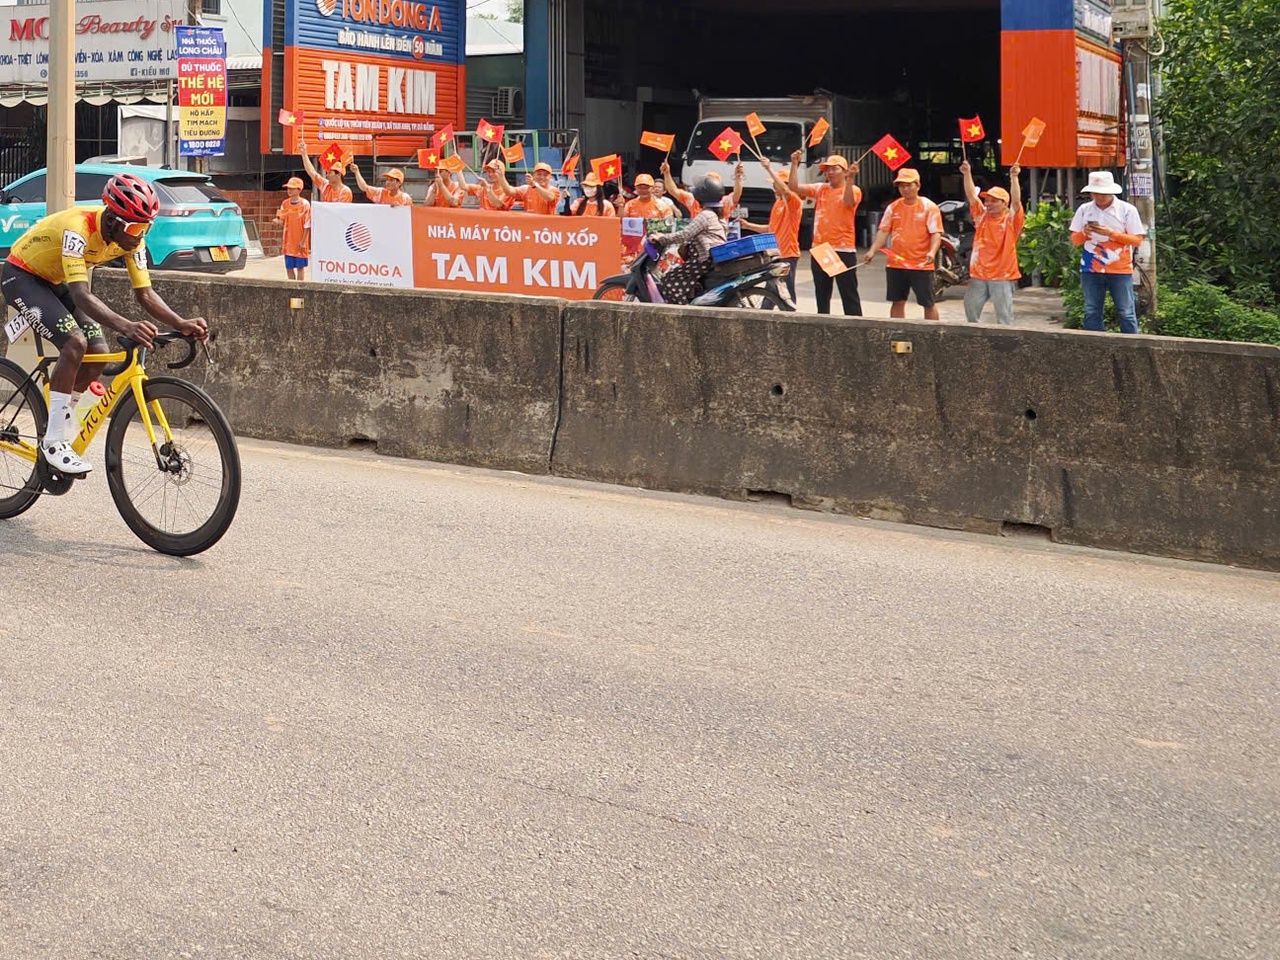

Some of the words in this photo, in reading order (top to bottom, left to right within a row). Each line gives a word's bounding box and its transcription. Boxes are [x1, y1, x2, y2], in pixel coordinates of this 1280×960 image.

[75, 14, 157, 40] Beauty
[428, 5, 443, 33] A
[178, 46, 201, 55] LONG
[201, 45, 223, 55] CHÂU
[181, 37, 195, 45] NHÀ
[337, 26, 356, 46] BẢO
[380, 33, 396, 51] LÊN
[396, 34, 412, 53] ĐẾN
[414, 42, 425, 54] 50
[166, 48, 178, 61] LAS
[181, 61, 193, 72] ĐỦ
[194, 60, 222, 72] THUỐC
[178, 73, 205, 90] THẾ
[207, 74, 225, 92] HỆ
[322, 59, 380, 112] TAM
[386, 66, 437, 116] KIM
[190, 90, 214, 106] MỚI
[63, 234, 85, 254] 157
[427, 221, 457, 239] NHÀ
[459, 223, 490, 242] MÁY
[493, 223, 522, 243] TÔN
[532, 225, 562, 245] TÔN
[566, 223, 598, 247] XỐP
[318, 260, 345, 273] TON
[348, 262, 389, 277] DONG
[391, 265, 403, 278] A
[431, 251, 509, 285] TAM
[522, 258, 597, 290] KIM
[9, 314, 25, 335] 157
[14, 297, 54, 339] BENEDICTION
